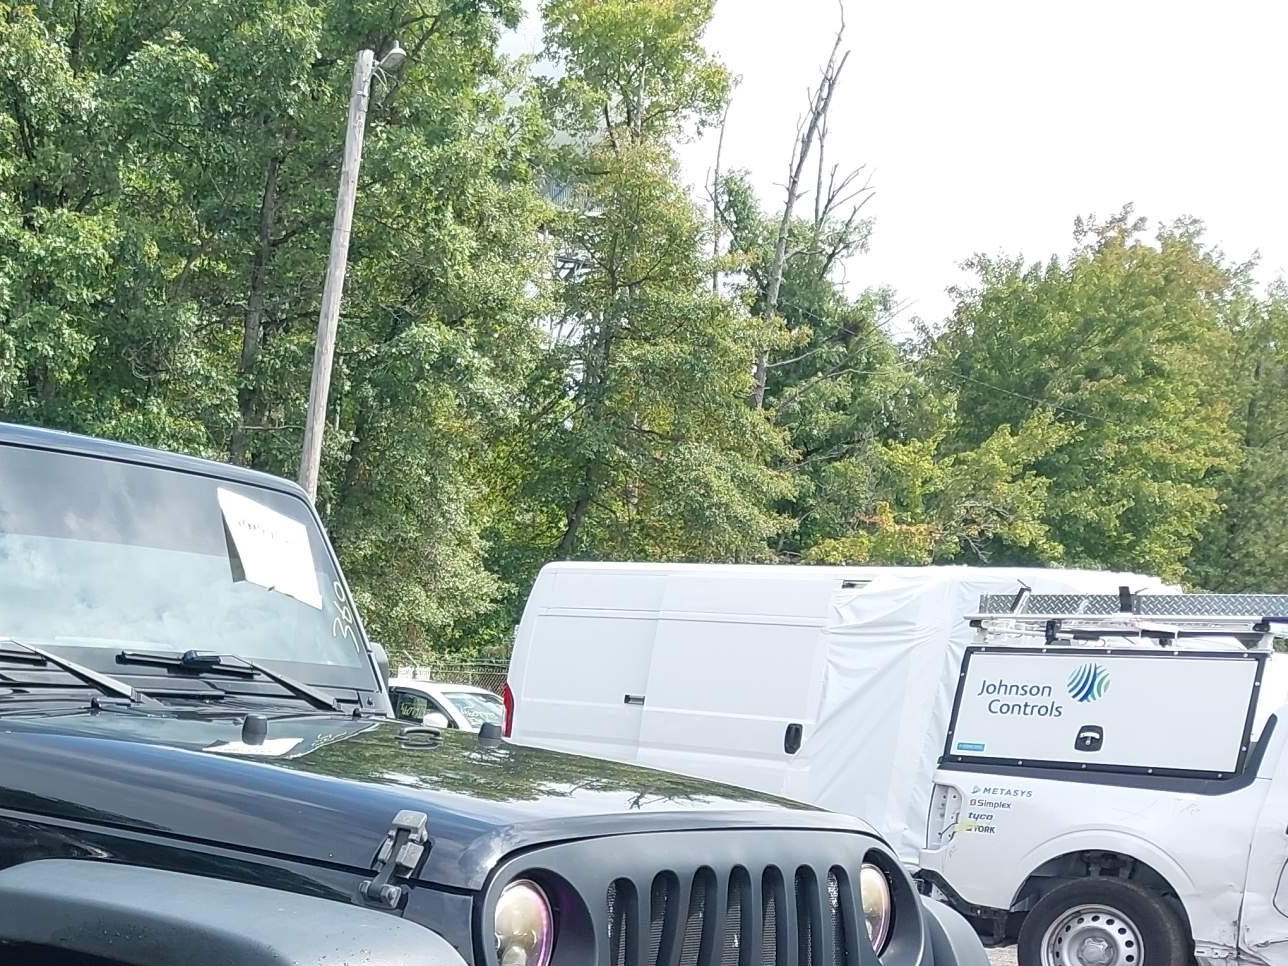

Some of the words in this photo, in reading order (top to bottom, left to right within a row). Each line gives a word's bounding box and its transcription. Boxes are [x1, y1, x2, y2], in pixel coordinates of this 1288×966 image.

[977, 679, 1052, 697] Johnson
[988, 699, 1063, 717] Controls
[982, 786, 1033, 798] METASYS
[978, 799, 1012, 809] Simplex
[967, 811, 994, 821] tyco
